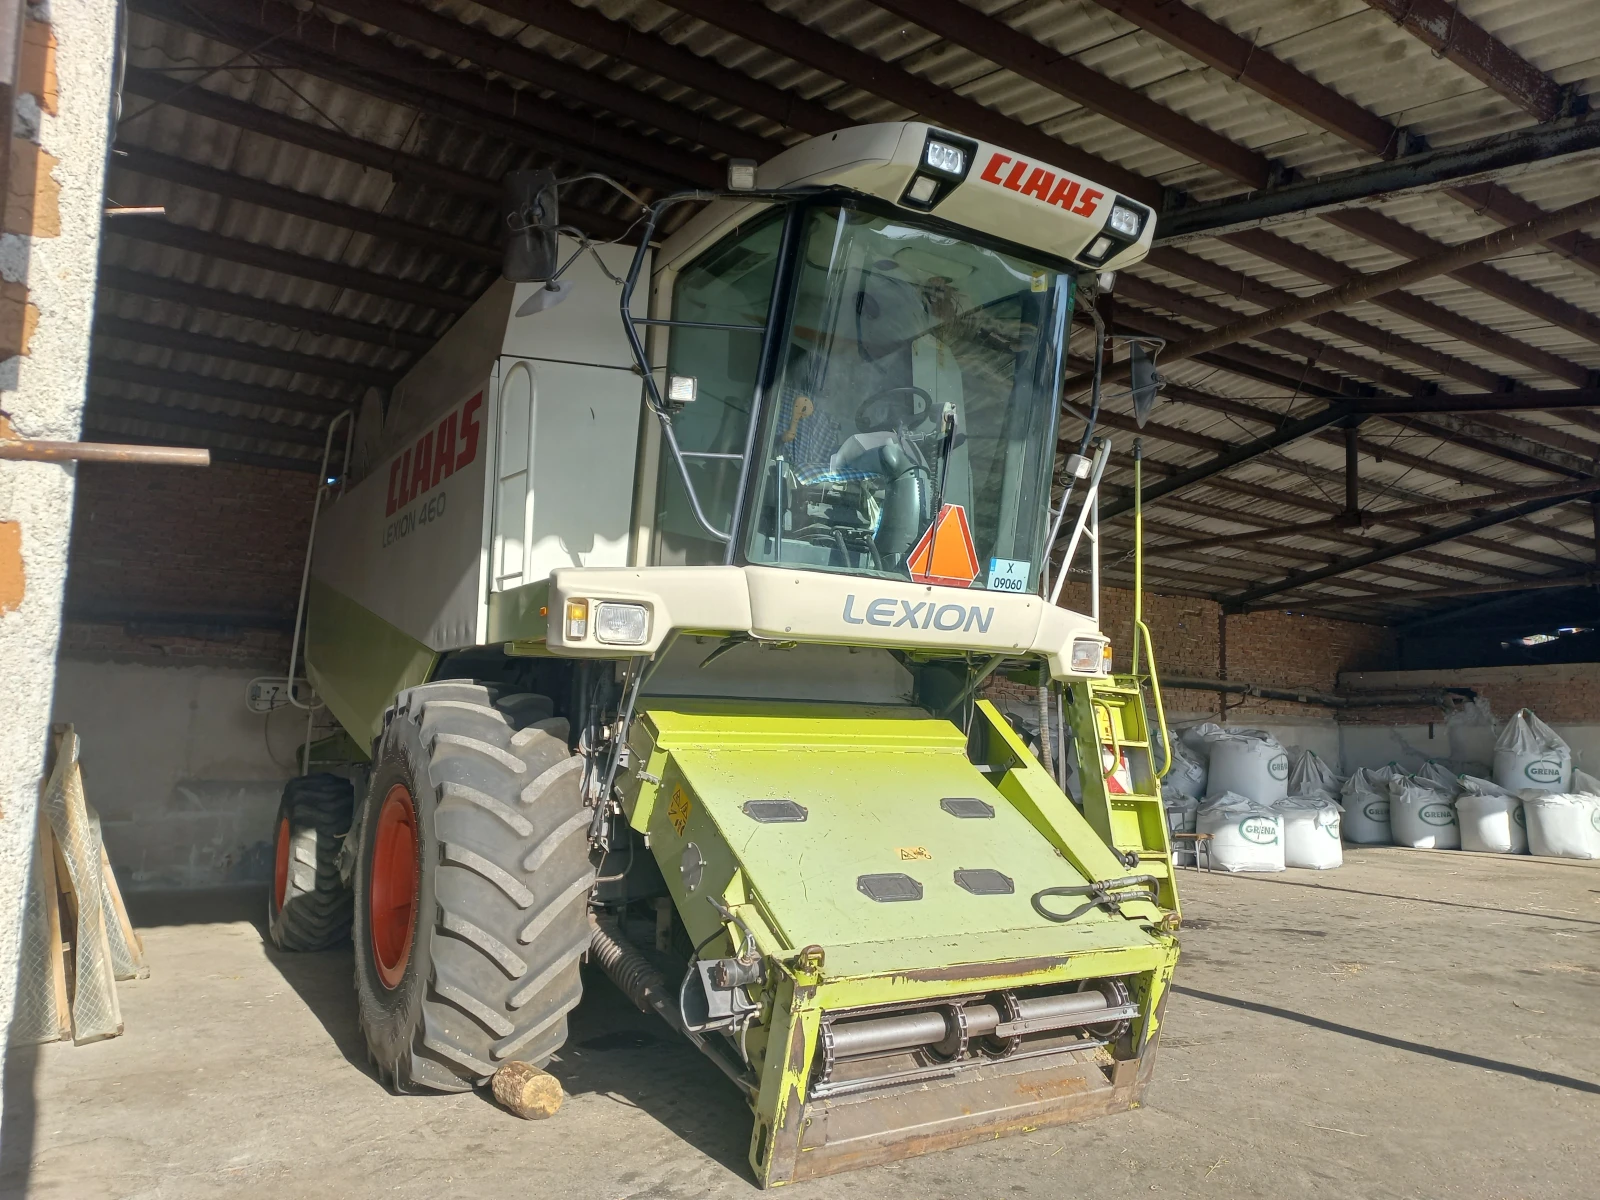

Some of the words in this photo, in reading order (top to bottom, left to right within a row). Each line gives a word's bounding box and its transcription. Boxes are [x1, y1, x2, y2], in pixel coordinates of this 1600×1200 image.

[980, 152, 1105, 219] CLAAS
[385, 389, 484, 519] CLAAS
[382, 508, 417, 548] LEXION
[418, 491, 447, 526] 460
[1006, 562, 1015, 574] X
[993, 577, 1023, 591] 09060
[842, 594, 995, 634] LEXION
[1530, 767, 1560, 776] GRENA
[1423, 810, 1453, 819] GRENA
[1245, 825, 1276, 835] GRENA
